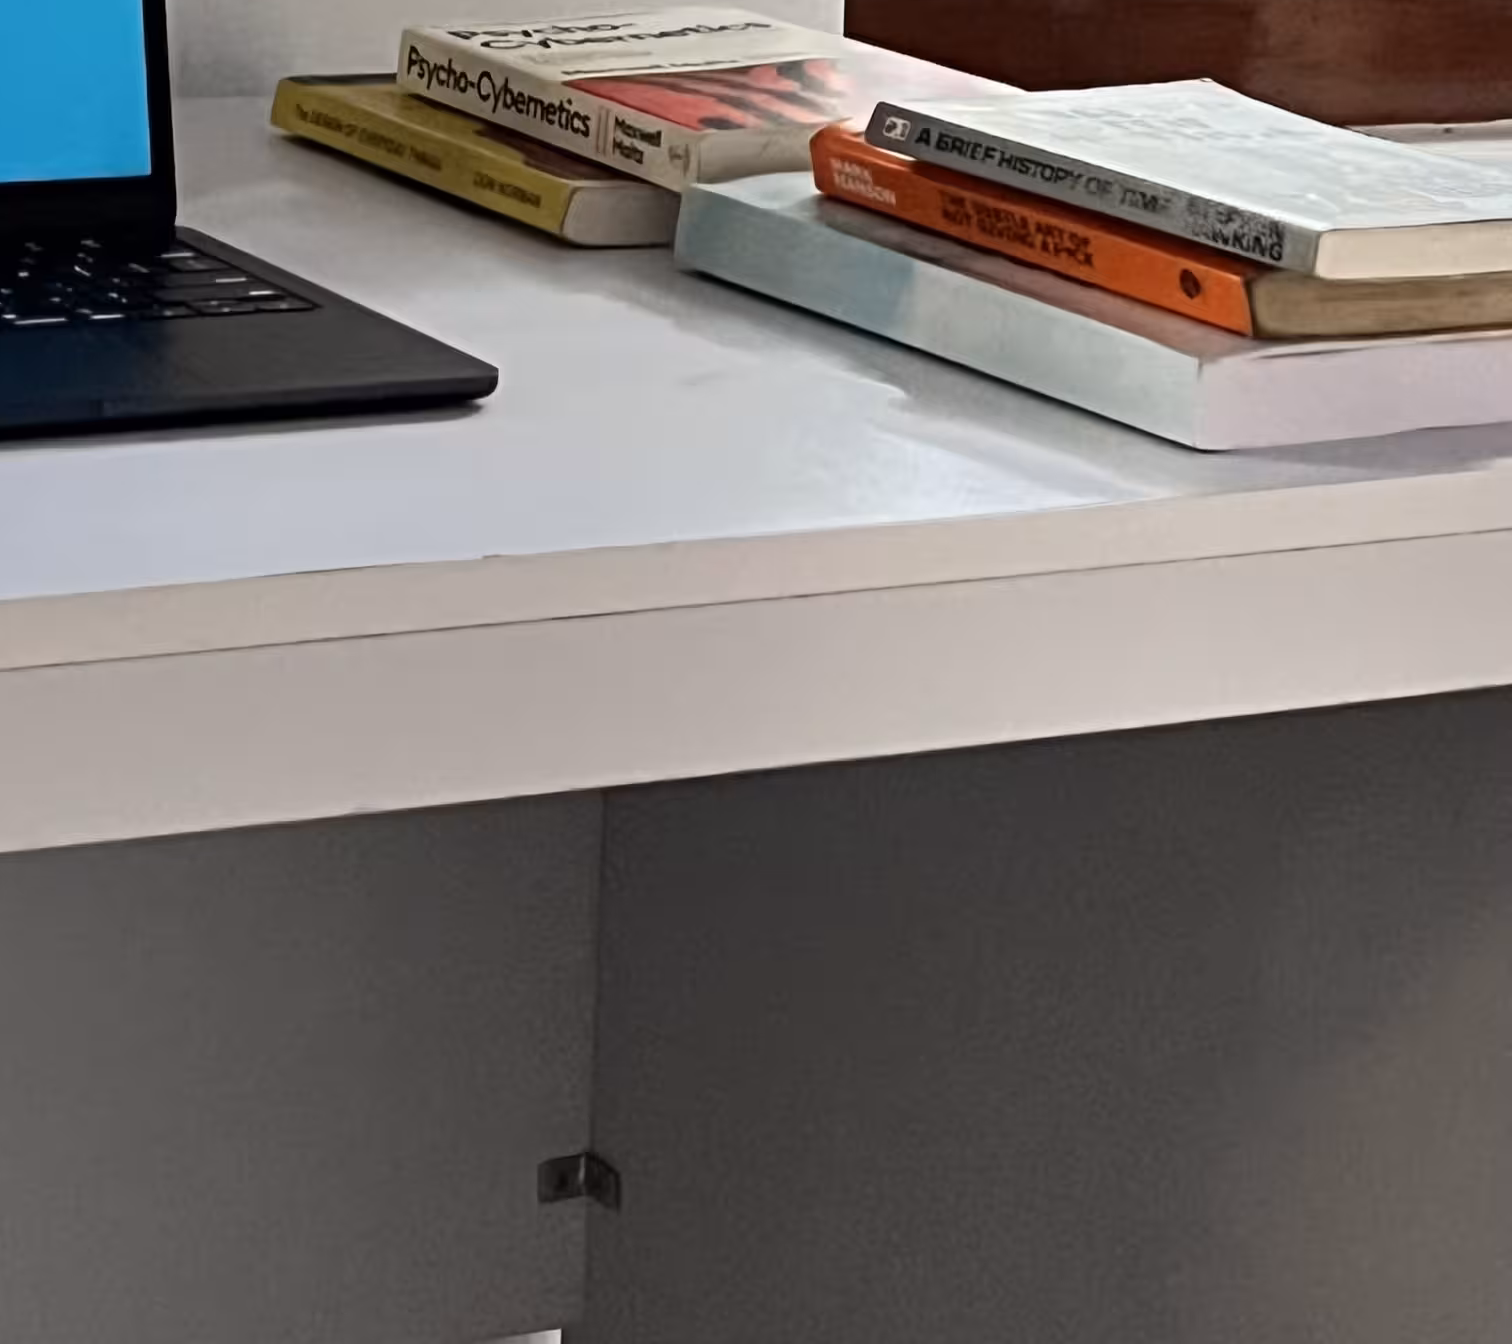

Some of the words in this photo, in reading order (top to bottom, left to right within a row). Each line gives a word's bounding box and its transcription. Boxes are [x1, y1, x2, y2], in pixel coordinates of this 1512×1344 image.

[407, 45, 592, 139] Psycho-Cybernetics
[914, 127, 932, 147] A
[935, 131, 996, 164] BRIEF
[997, 150, 1084, 190] HISTORY
